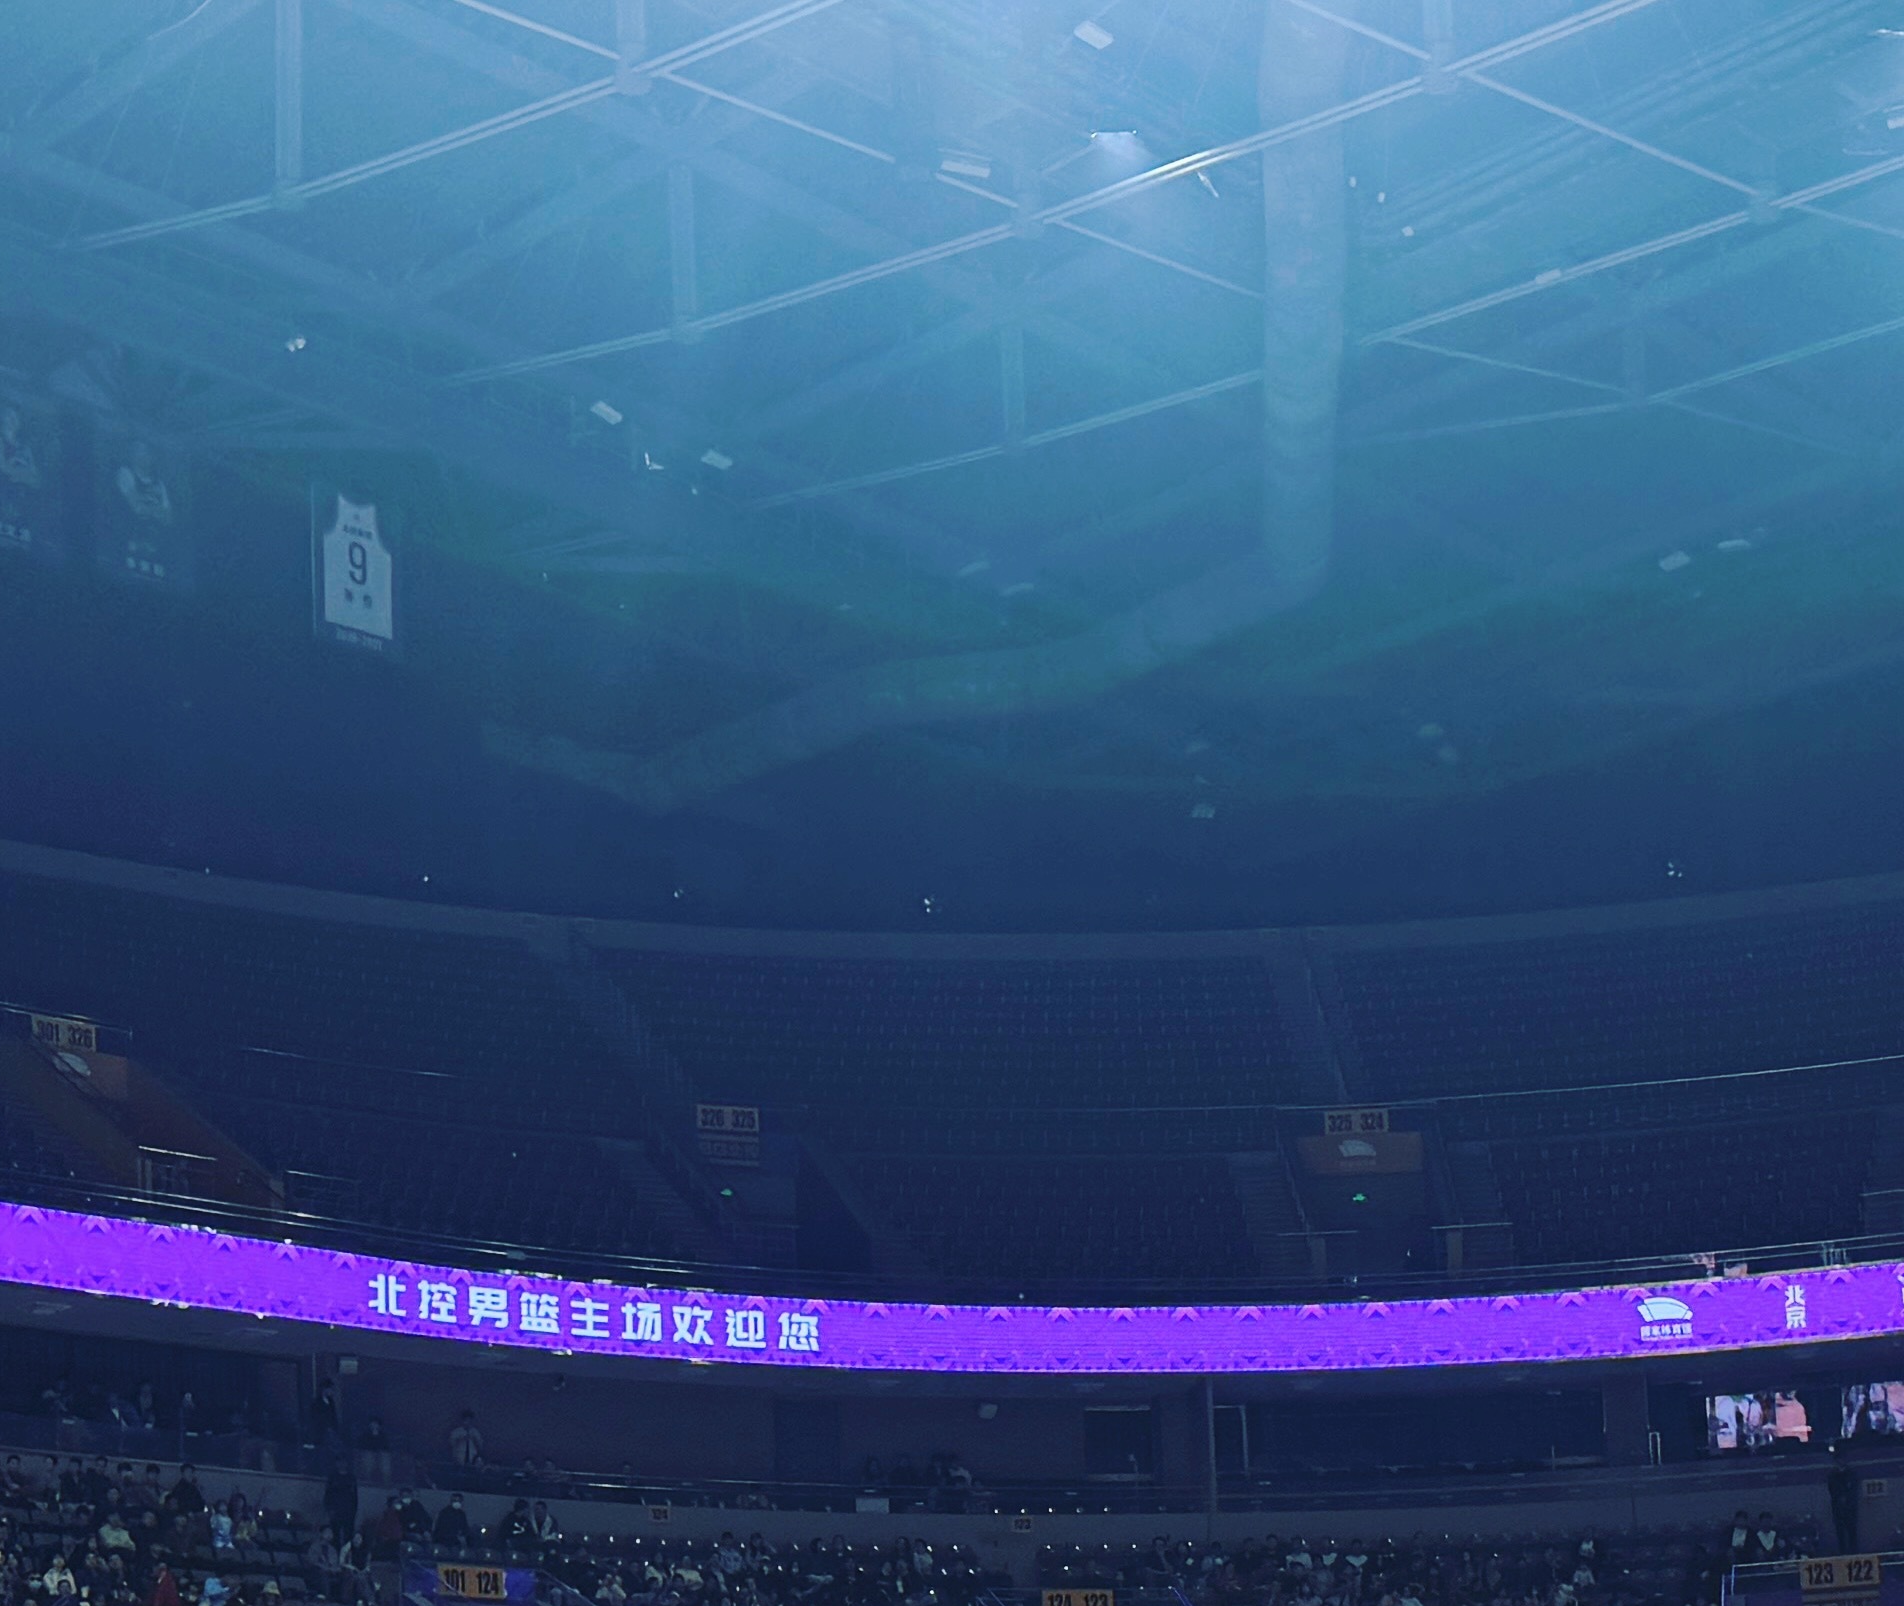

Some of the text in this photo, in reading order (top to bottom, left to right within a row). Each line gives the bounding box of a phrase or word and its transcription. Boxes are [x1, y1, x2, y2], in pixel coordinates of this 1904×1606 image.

[349, 541, 367, 586] 9
[368, 1273, 822, 1353] 北控男篮主场欢迎您
[1785, 1284, 1807, 1329] 北京
[444, 1569, 499, 1595] 101 124
[1805, 1560, 1874, 1585] 123 122
